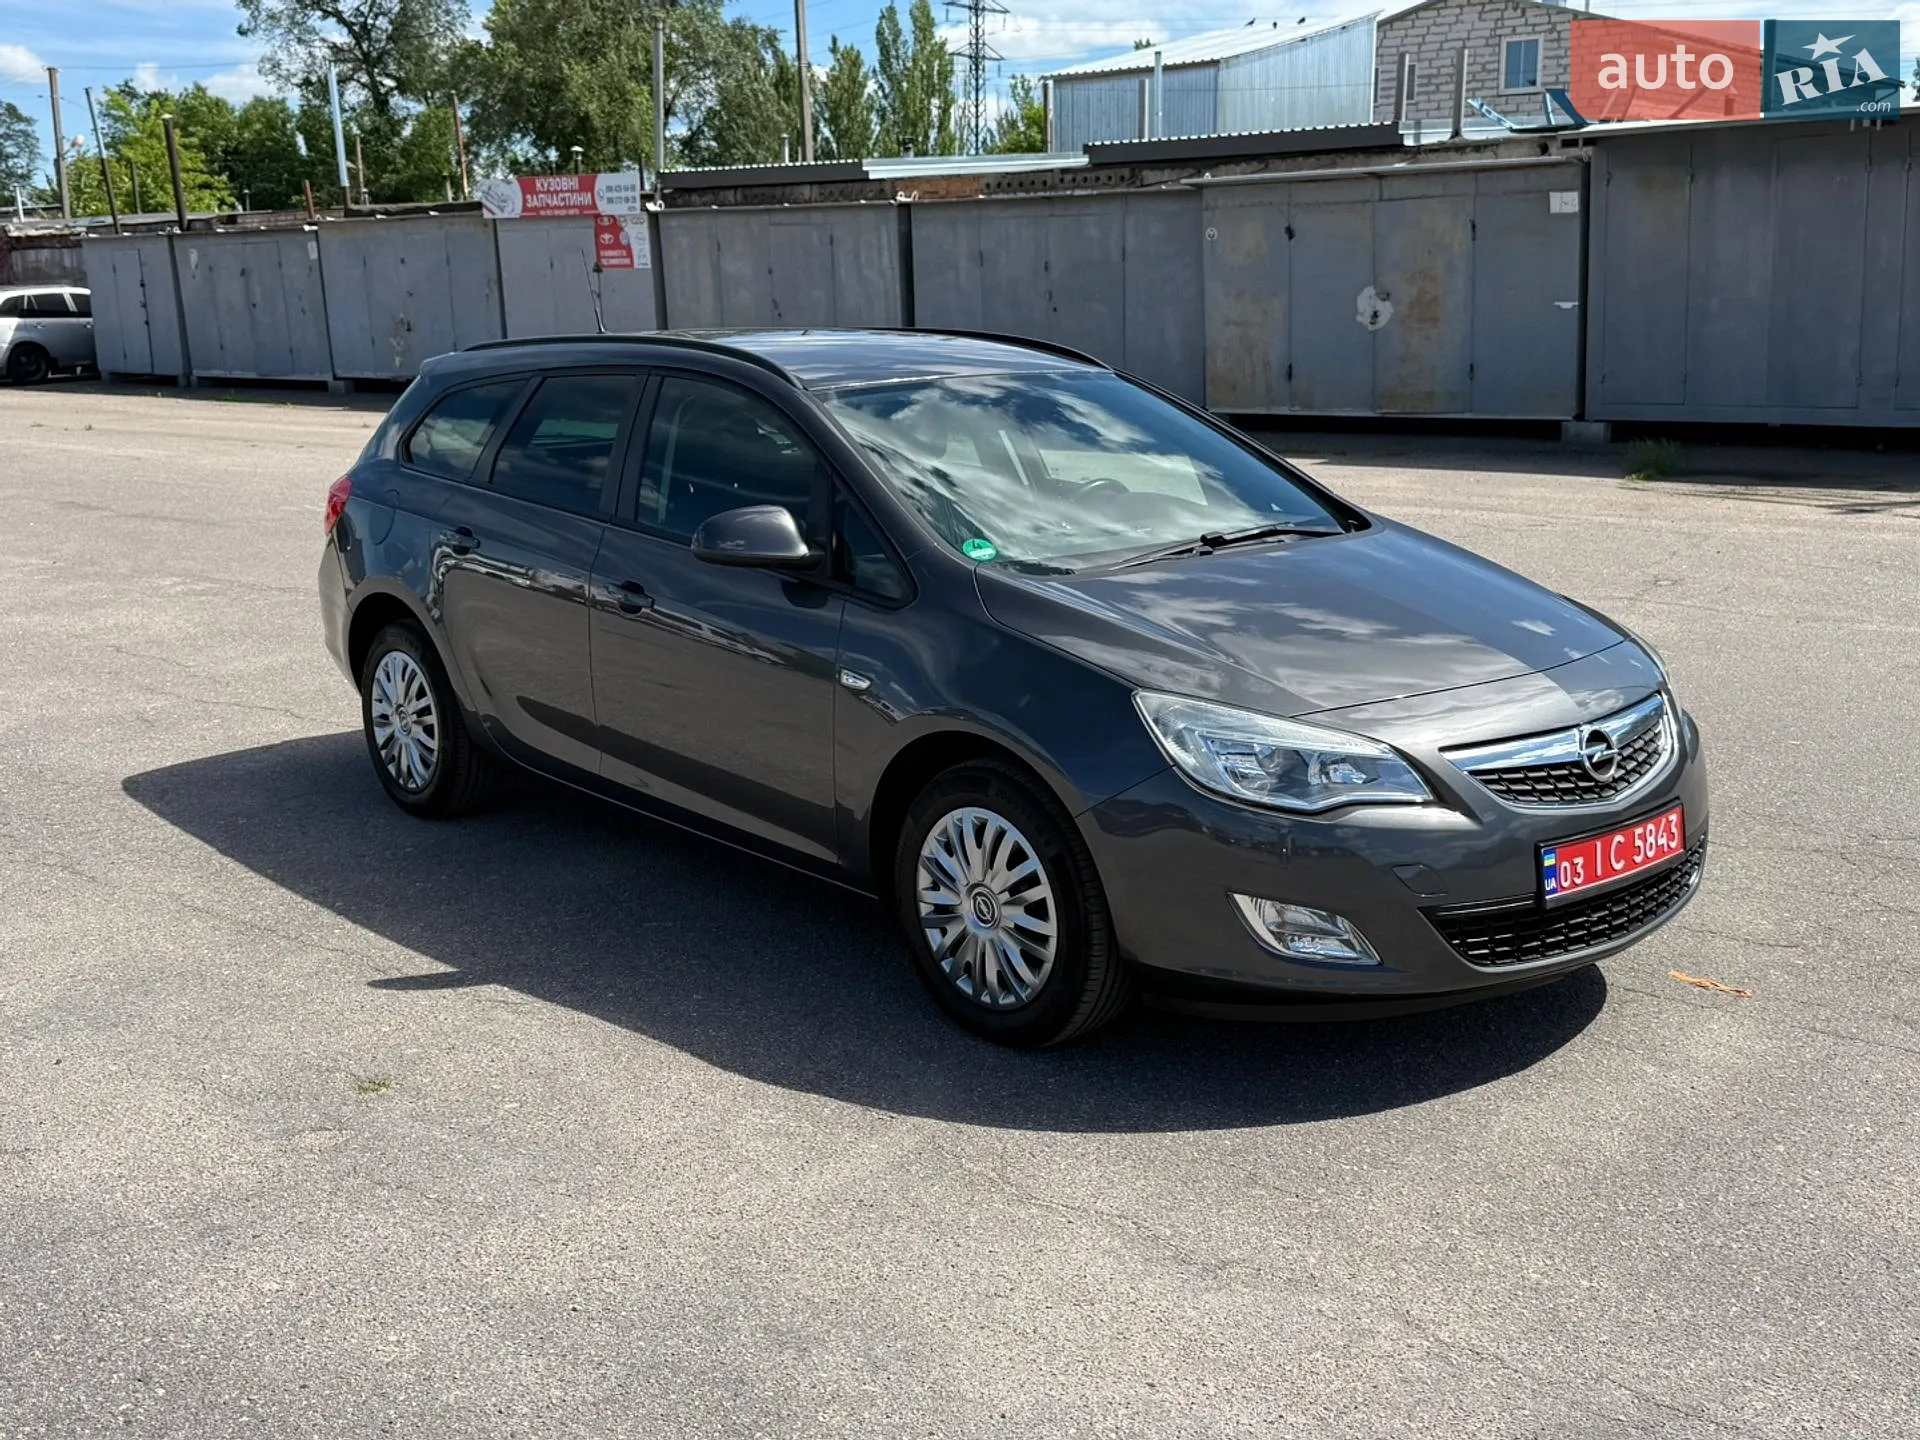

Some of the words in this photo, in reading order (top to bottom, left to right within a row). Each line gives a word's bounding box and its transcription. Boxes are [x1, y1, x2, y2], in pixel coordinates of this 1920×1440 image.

[535, 176, 579, 192] КУЗОВНІ
[525, 192, 592, 208] ЗАПЧАСТИНИ
[1560, 856, 1585, 888] 03
[1594, 834, 1626, 877] IC
[1632, 813, 1678, 864] 5843
[1545, 877, 1557, 891] UA
